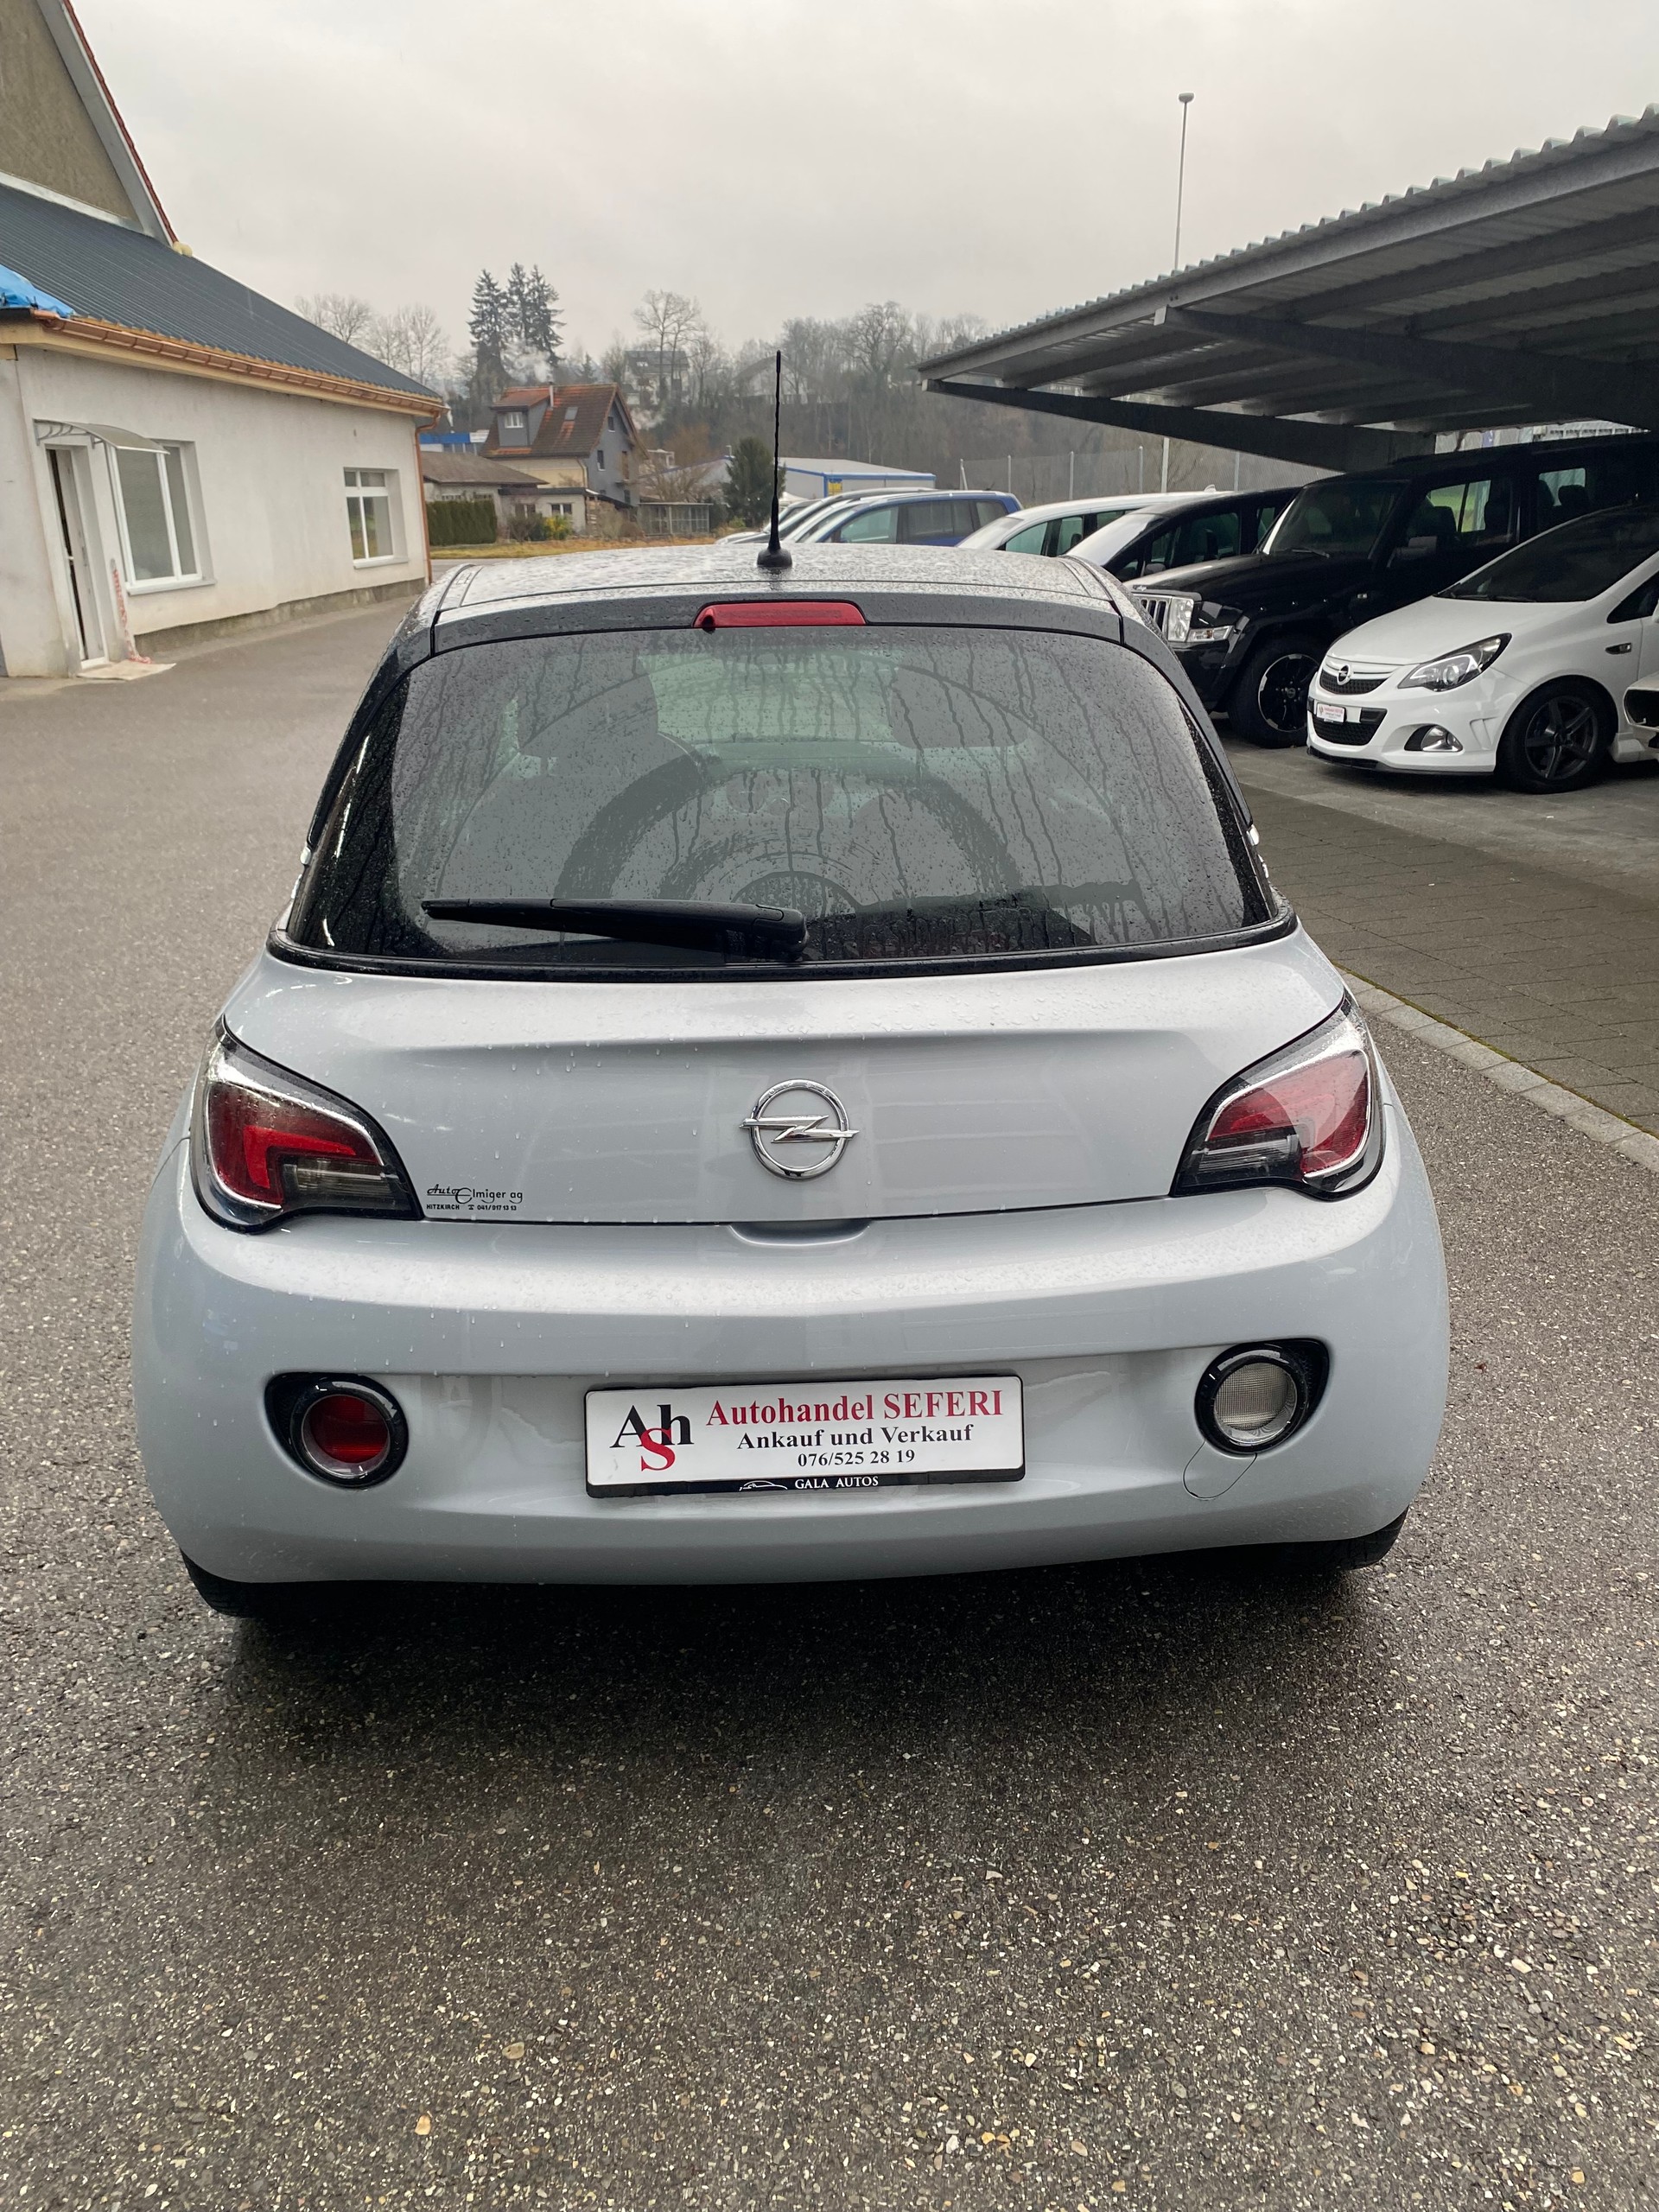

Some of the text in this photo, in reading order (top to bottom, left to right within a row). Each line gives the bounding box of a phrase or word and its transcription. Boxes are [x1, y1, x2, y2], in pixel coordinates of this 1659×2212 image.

[427, 1184, 523, 1204] Auto Elmiger ag
[706, 1389, 1004, 1426] Autohandel SEFERI
[737, 1424, 975, 1449] Ankauf und Verkauf
[798, 1449, 916, 1467] 076/525 28 19
[794, 1476, 879, 1490] GALA AUTOS
